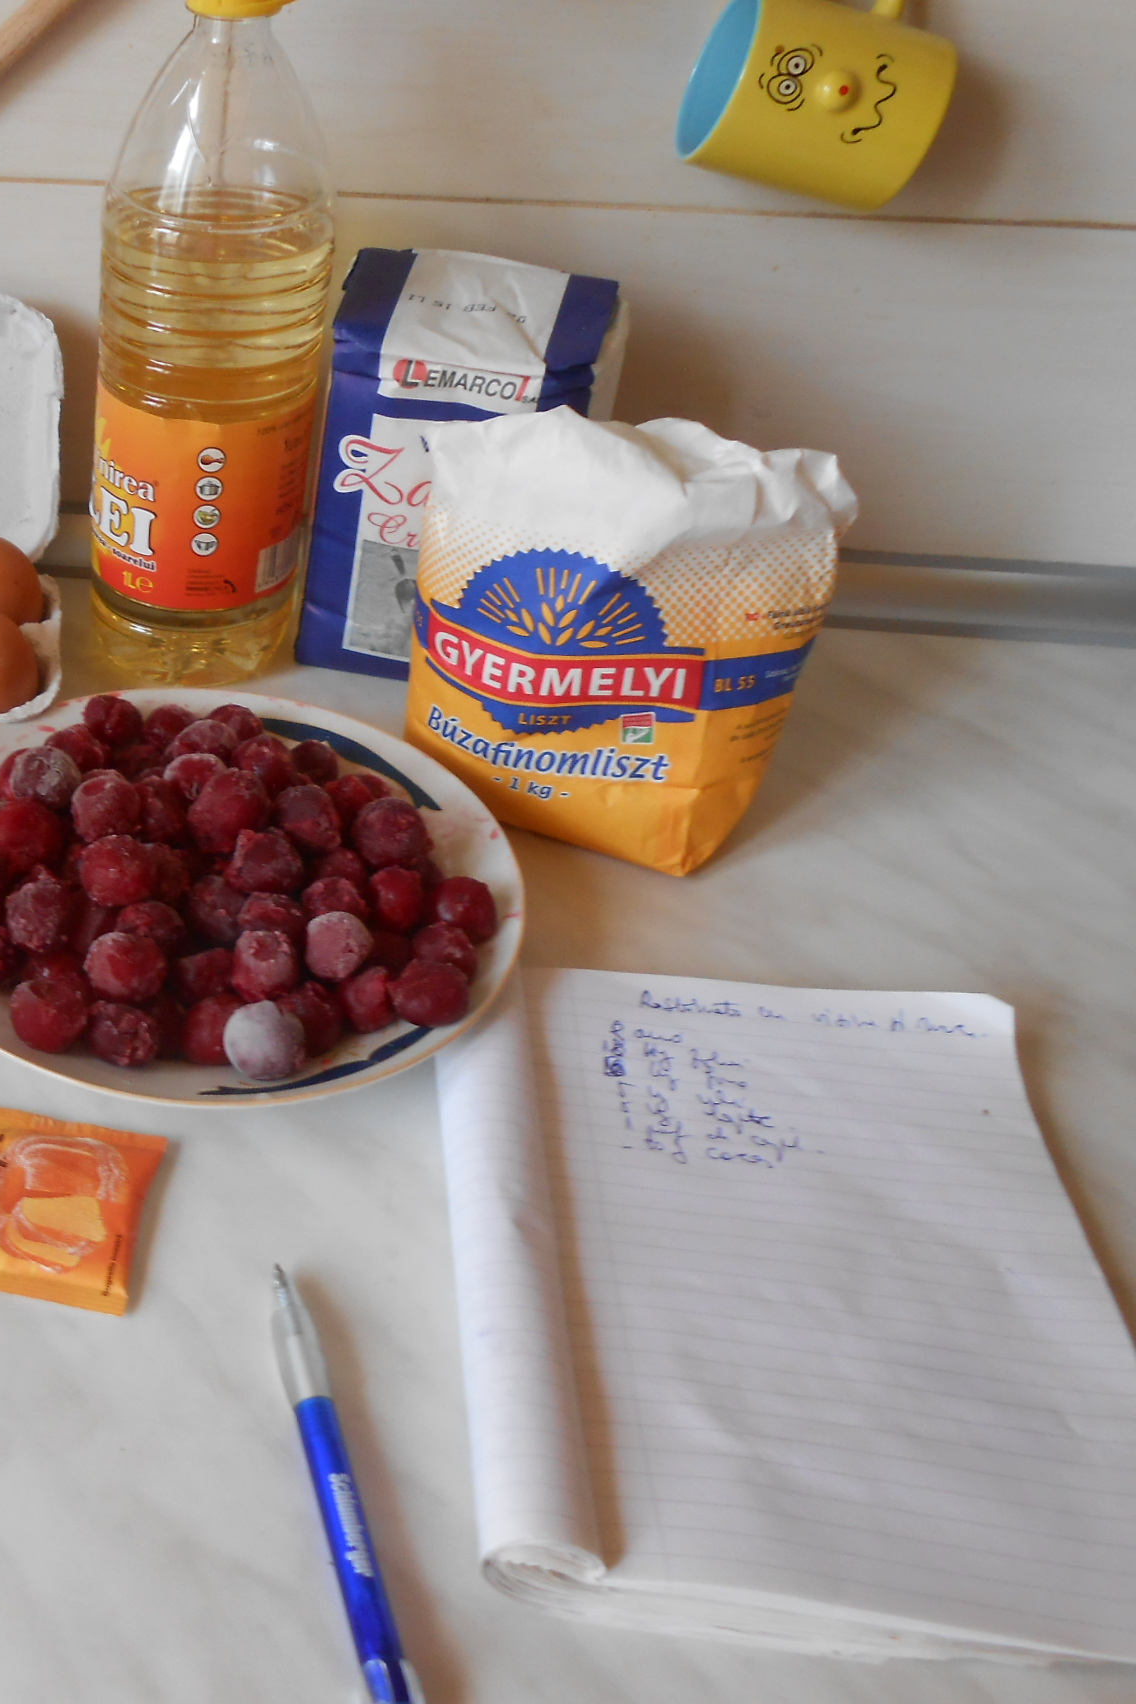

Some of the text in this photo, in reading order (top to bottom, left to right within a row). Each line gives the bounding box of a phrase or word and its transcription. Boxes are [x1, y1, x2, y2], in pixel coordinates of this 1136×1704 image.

[463, 303, 496, 312] FEB
[433, 632, 687, 699] GYERMELYI
[737, 675, 757, 690] 55
[518, 713, 572, 726] LISZT
[427, 705, 669, 781] Búzafinomliszt
[508, 777, 553, 799] 1 kg
